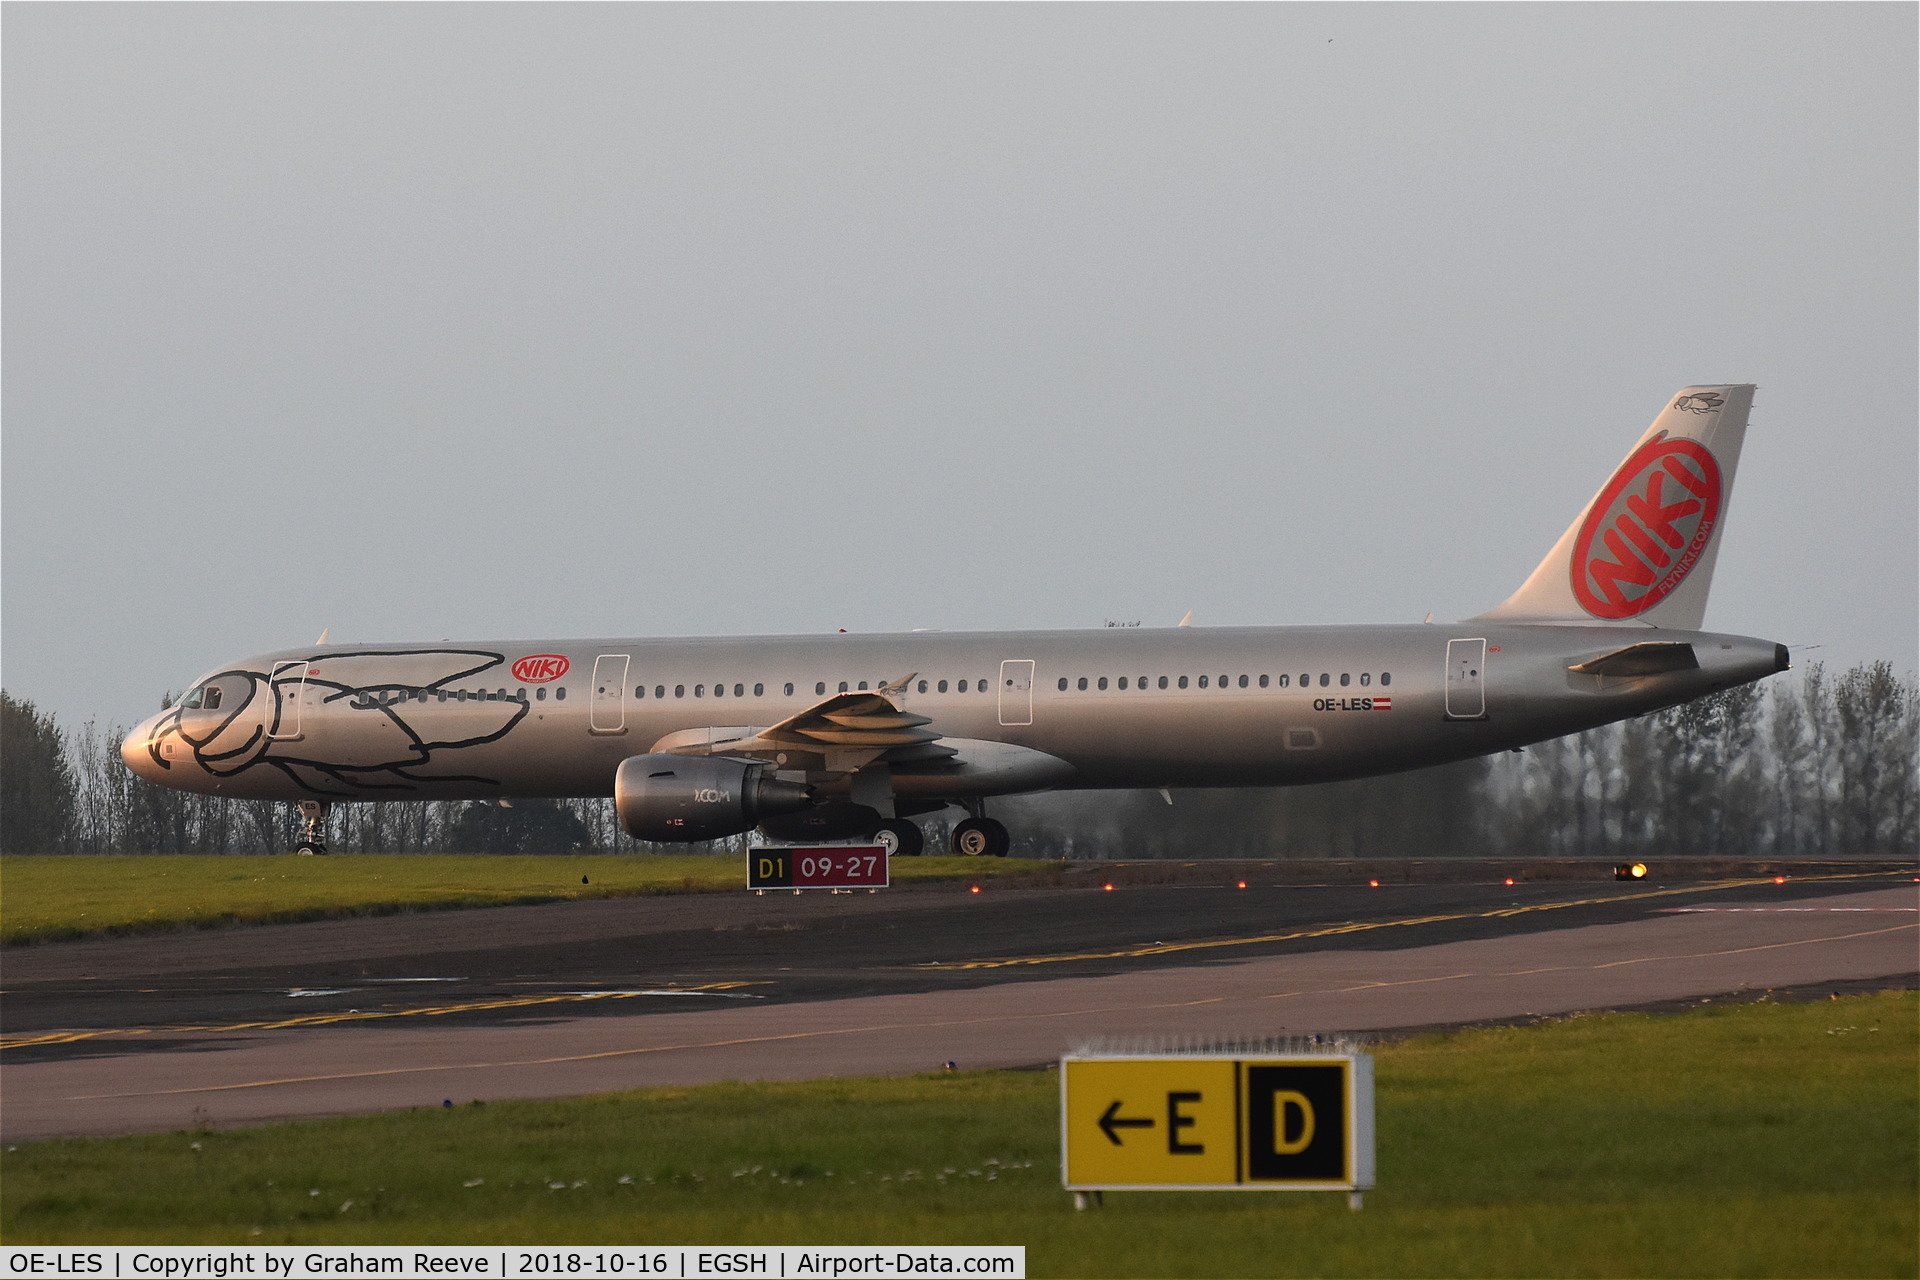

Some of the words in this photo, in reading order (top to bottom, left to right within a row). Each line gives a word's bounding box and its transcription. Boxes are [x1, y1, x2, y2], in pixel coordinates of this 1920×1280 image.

[1589, 455, 1709, 604] NIKI
[1657, 519, 1714, 594] FLYNIKI.COM
[516, 659, 564, 678] NIKI
[1313, 697, 1372, 711] OE-LES
[759, 857, 783, 879] D1
[801, 856, 877, 877] 09-27
[1168, 1091, 1205, 1155] E
[1272, 1088, 1316, 1155] D
